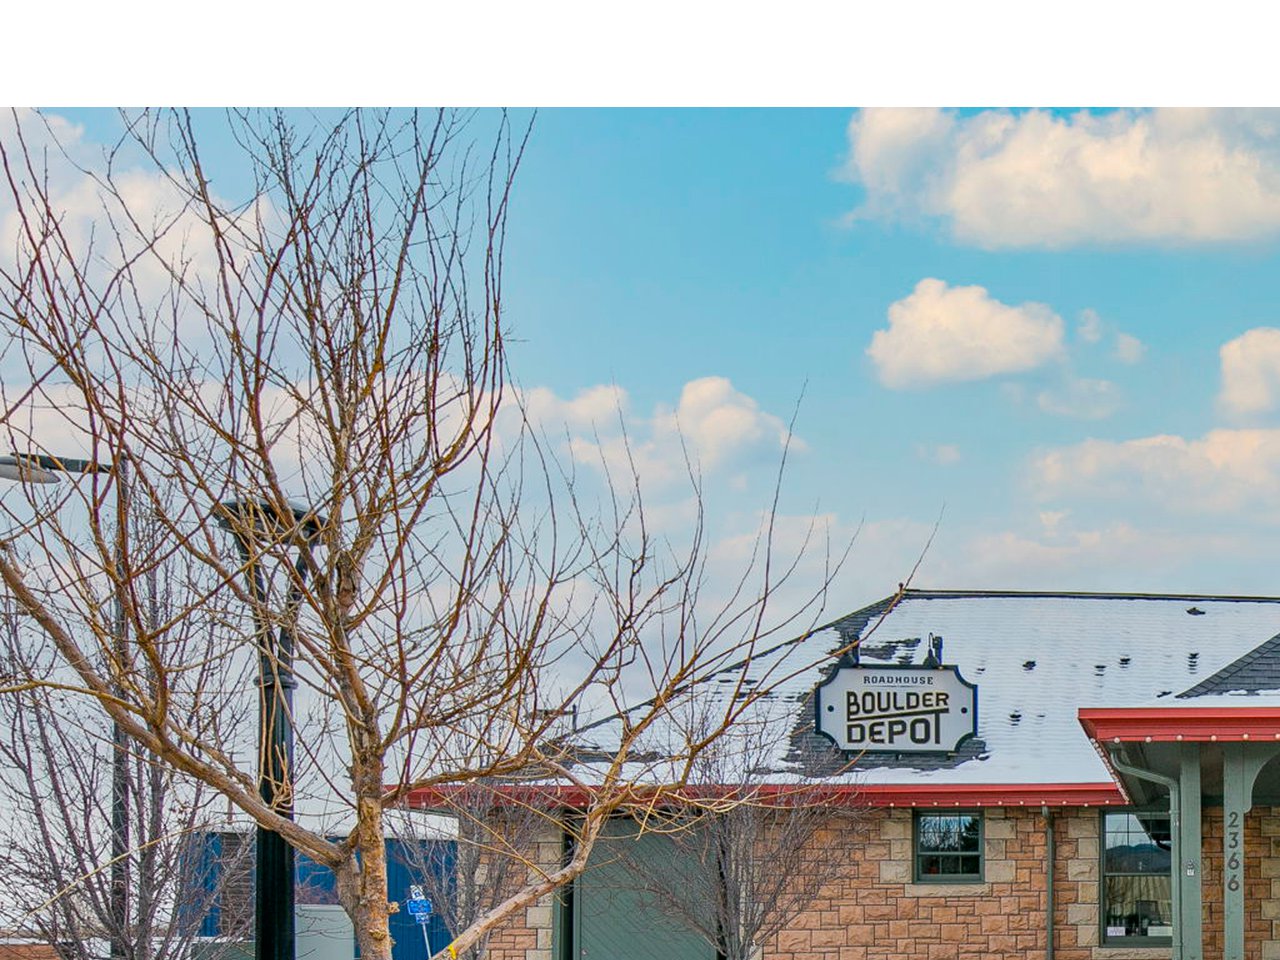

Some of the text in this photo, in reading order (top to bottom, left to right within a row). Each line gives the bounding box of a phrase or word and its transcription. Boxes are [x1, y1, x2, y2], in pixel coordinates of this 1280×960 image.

[863, 675, 934, 685] ROADHOUSE
[846, 691, 950, 716] BOULDER
[846, 711, 943, 745] DEPOT
[1228, 811, 1240, 892] 2366
